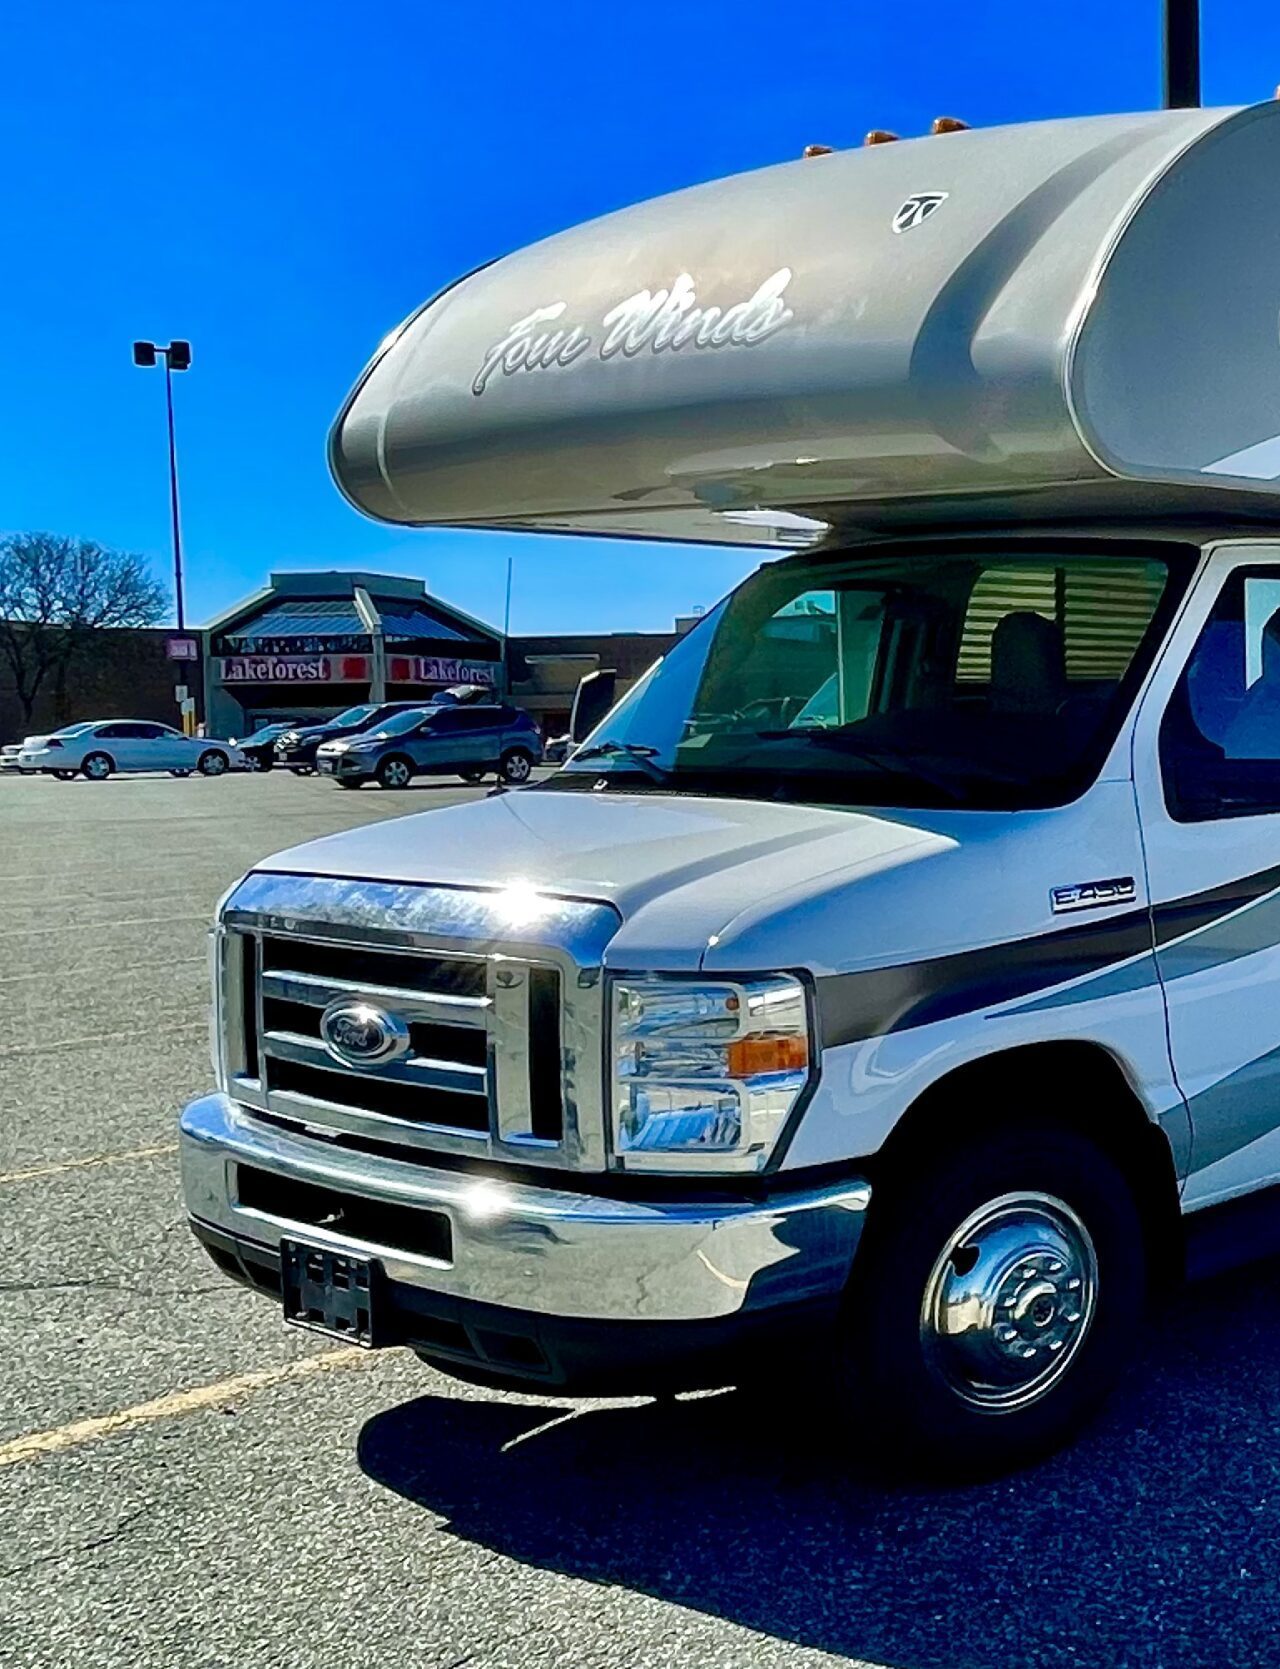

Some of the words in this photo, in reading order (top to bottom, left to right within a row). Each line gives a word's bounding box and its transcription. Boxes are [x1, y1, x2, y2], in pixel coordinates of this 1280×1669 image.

[472, 301, 591, 396] Four
[600, 267, 794, 361] Winds
[219, 656, 327, 681] Lakeforest
[419, 657, 496, 684] Lakeforest
